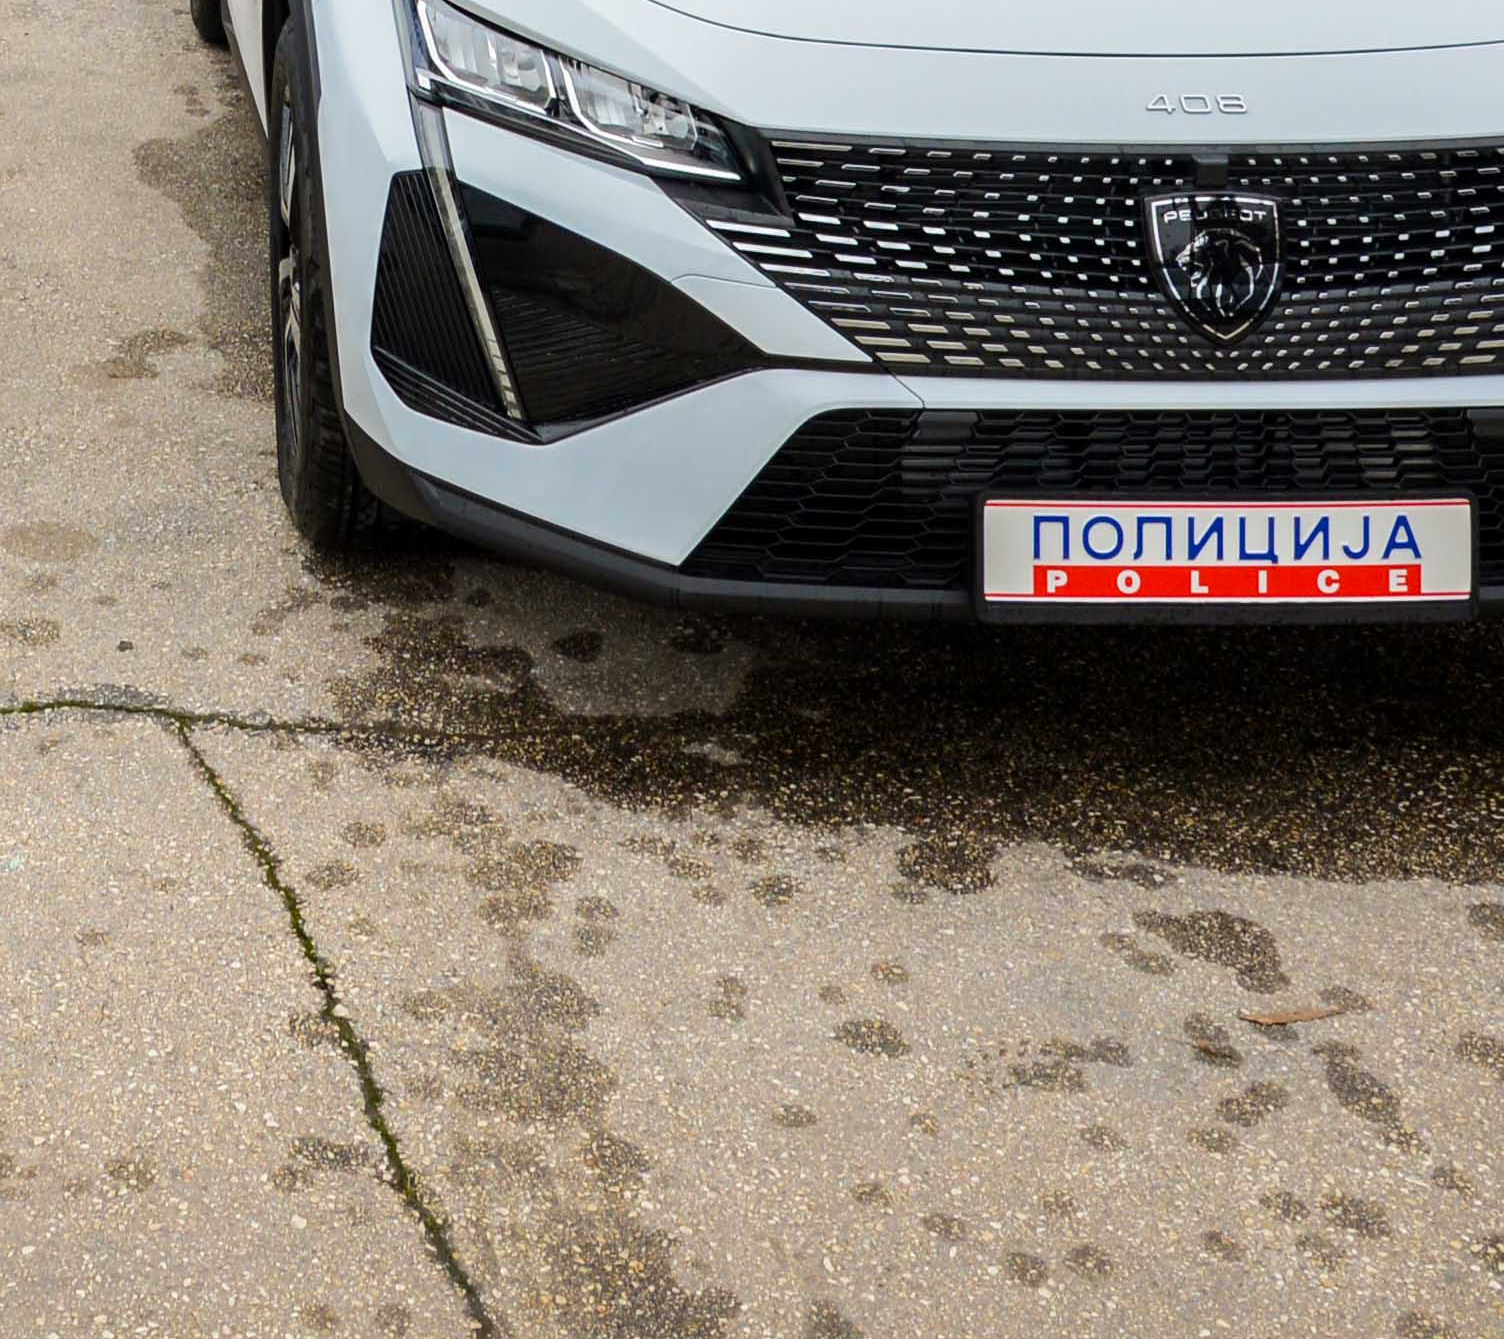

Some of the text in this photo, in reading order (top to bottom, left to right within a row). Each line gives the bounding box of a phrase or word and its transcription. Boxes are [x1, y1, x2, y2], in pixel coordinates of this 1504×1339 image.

[1146, 93, 1248, 114] 408
[1033, 515, 1422, 565] ПОЛИЦИЈА
[1047, 568, 1409, 594] POLICE
